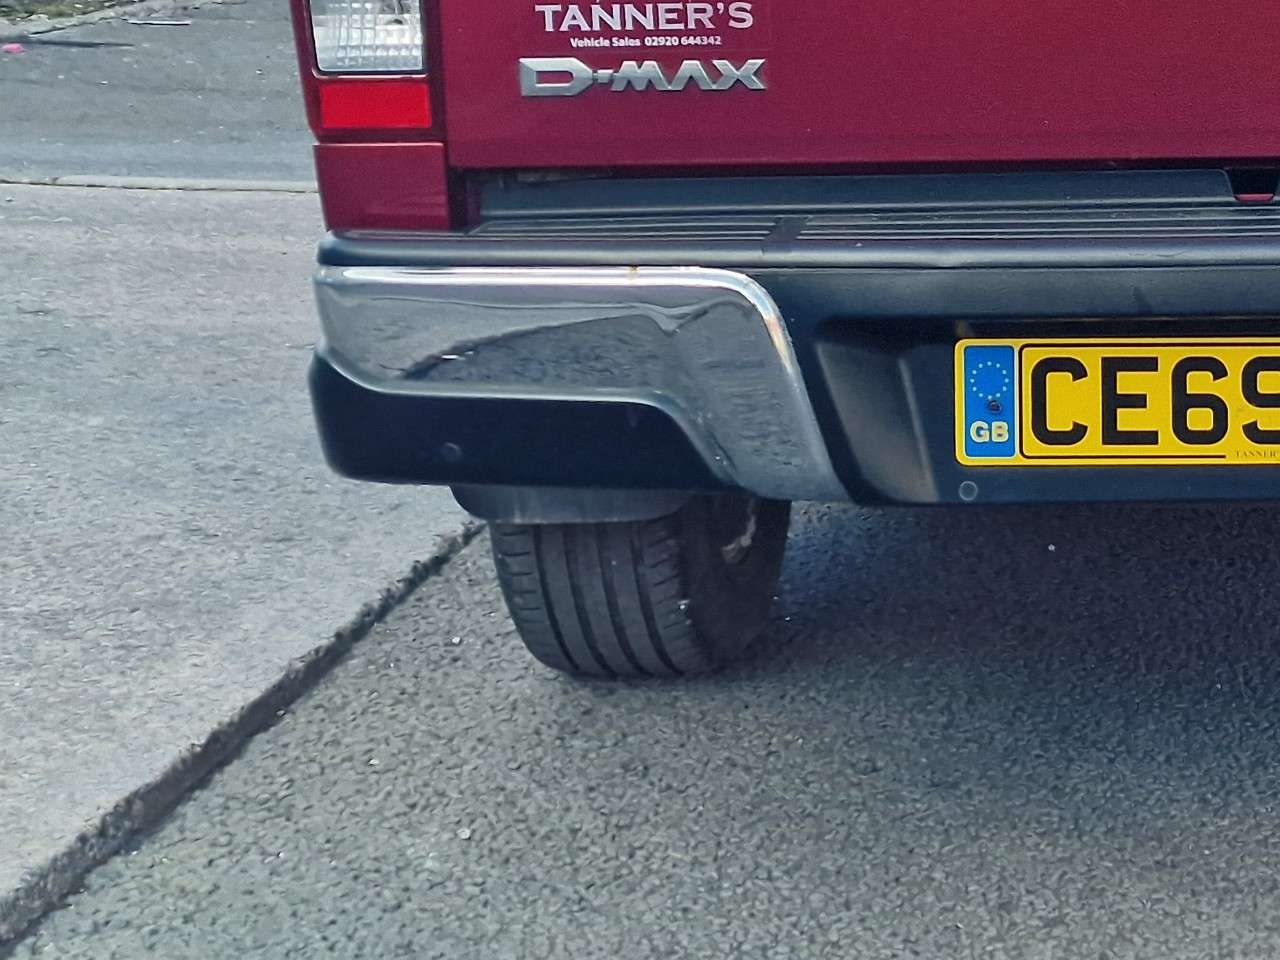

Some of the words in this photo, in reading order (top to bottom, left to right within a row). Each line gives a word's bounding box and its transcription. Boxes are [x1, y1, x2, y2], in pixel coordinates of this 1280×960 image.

[534, 1, 754, 32] TANNER'S
[570, 37, 610, 48] Vehicle
[611, 37, 641, 47] Sales
[644, 36, 679, 47] 02920
[680, 35, 722, 46] 644342
[518, 56, 767, 97] D-MAX
[969, 420, 1009, 443] GB
